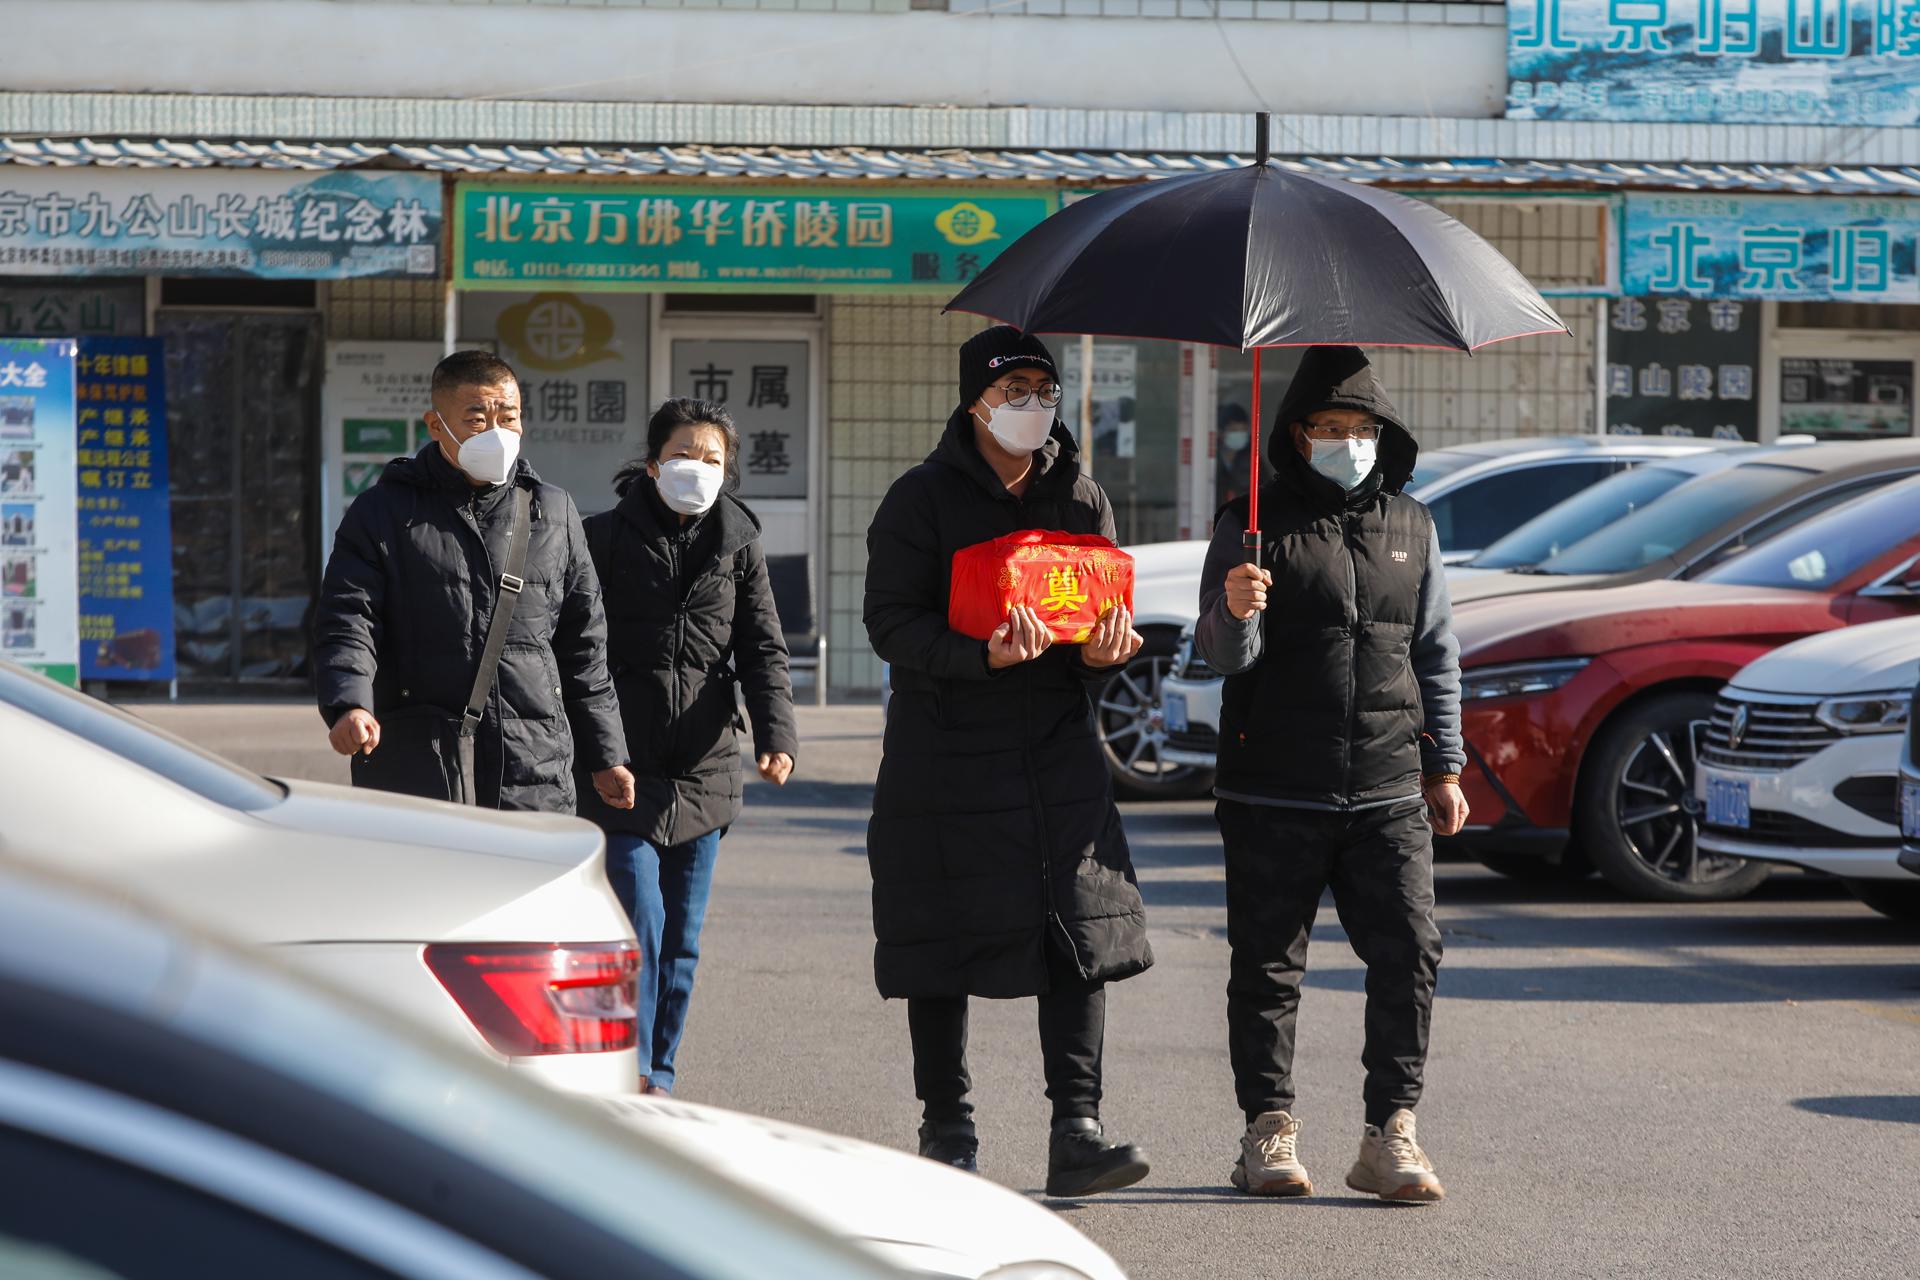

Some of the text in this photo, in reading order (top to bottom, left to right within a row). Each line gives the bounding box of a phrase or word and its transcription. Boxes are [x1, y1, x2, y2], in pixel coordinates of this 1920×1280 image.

[474, 195, 893, 248] 北京万佛华侨陵园
[1653, 224, 1889, 292] 北京归
[1612, 299, 1743, 333] 北京市
[1, 360, 48, 389] 大全
[689, 362, 790, 409] 市属
[529, 428, 626, 443] CEMETERY
[747, 430, 791, 476] 墓
[1040, 564, 1089, 611] 奠
